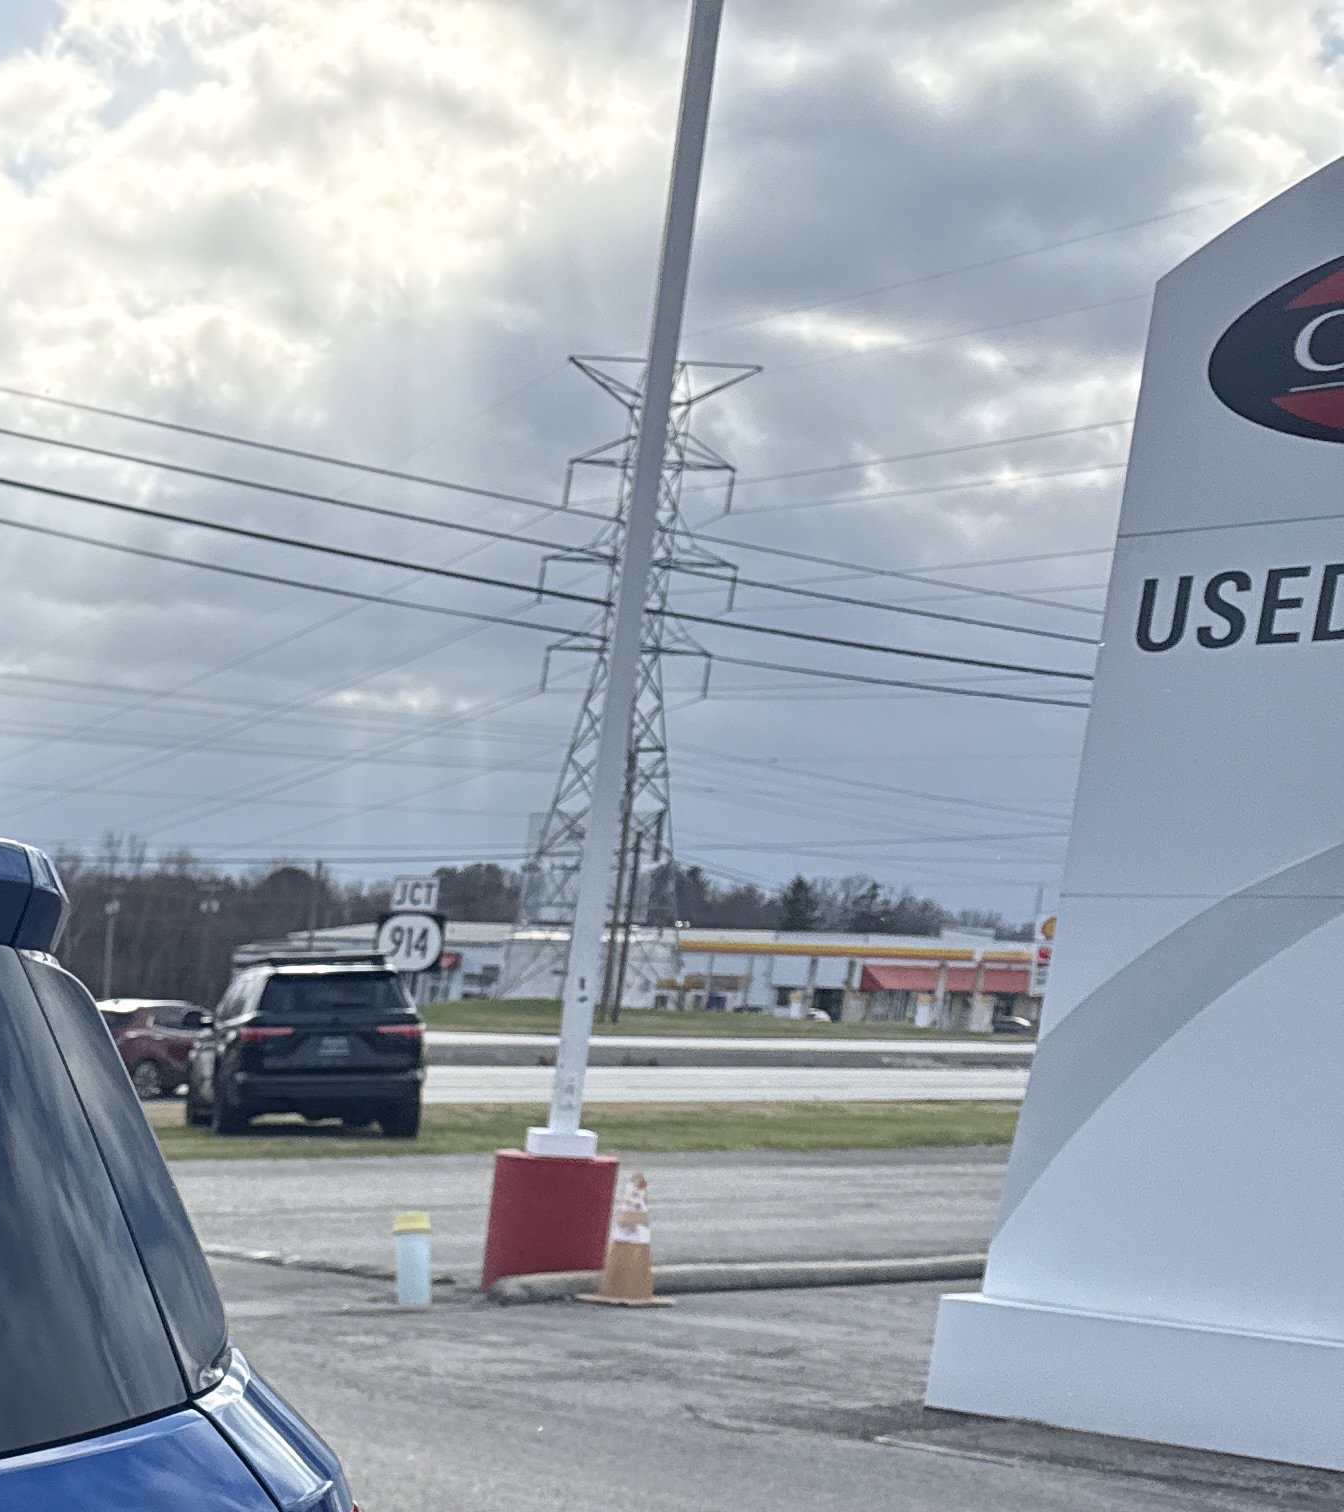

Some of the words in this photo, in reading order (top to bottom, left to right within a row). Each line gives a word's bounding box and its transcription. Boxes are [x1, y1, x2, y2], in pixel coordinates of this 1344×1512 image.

[1136, 563, 1344, 652] USED
[393, 882, 434, 906] JCT
[391, 925, 429, 959] 914
